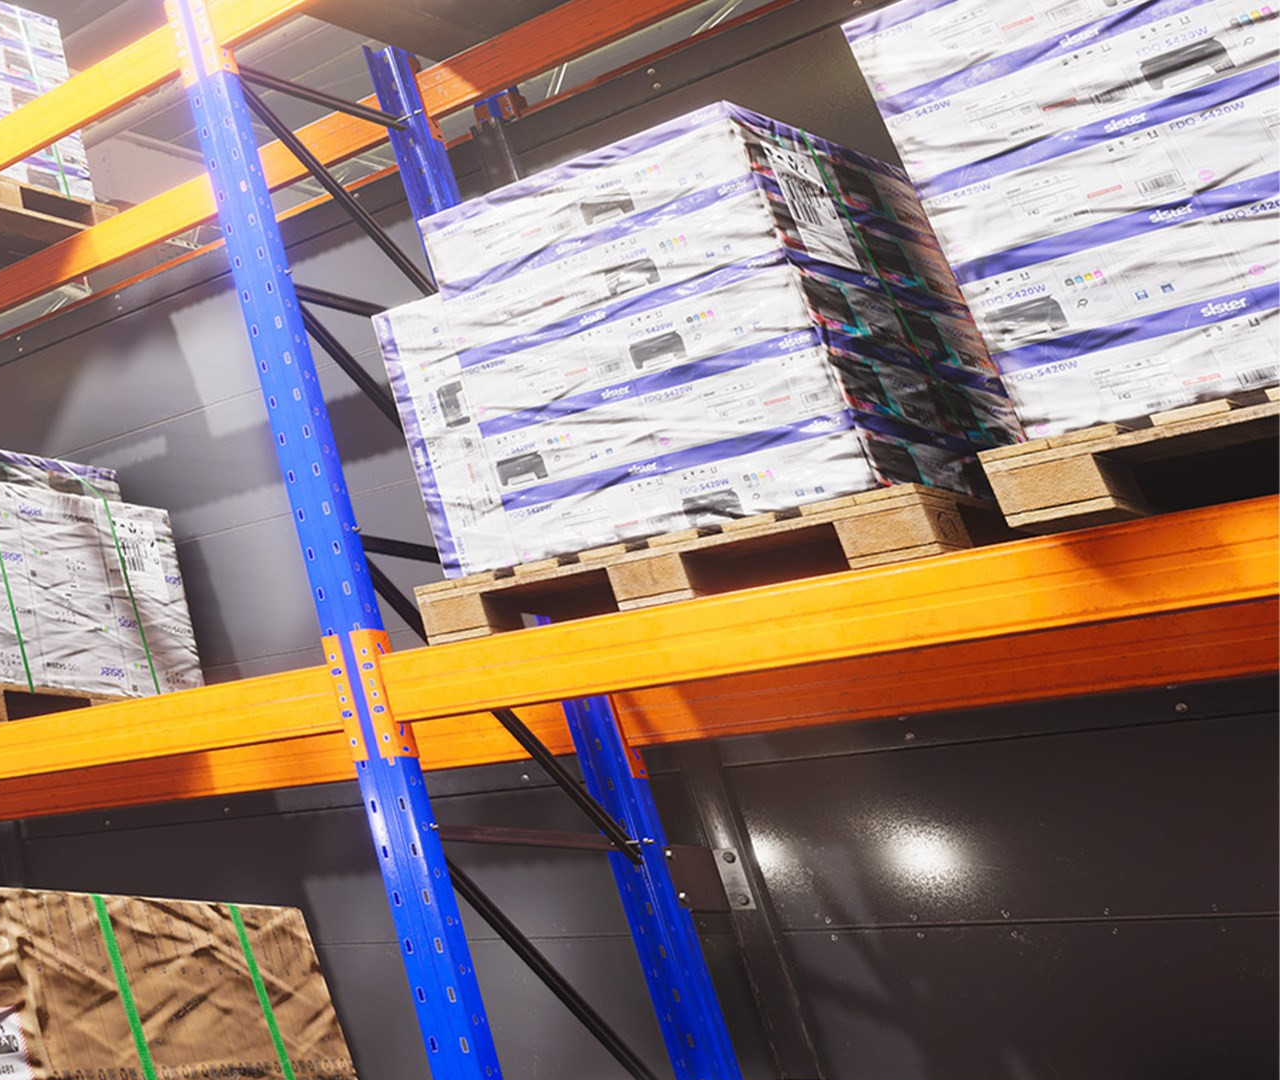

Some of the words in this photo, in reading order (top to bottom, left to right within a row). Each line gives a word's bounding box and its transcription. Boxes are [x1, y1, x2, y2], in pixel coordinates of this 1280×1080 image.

[1059, 28, 1101, 48] sister
[1103, 111, 1147, 134] sister
[1168, 101, 1245, 132] FDQ-S420W
[1147, 203, 1194, 223] sister
[980, 284, 1047, 309] FDQ-S420W
[1200, 296, 1248, 318] sister
[778, 332, 812, 350] sister
[1008, 360, 1079, 383] FDQ-S420W
